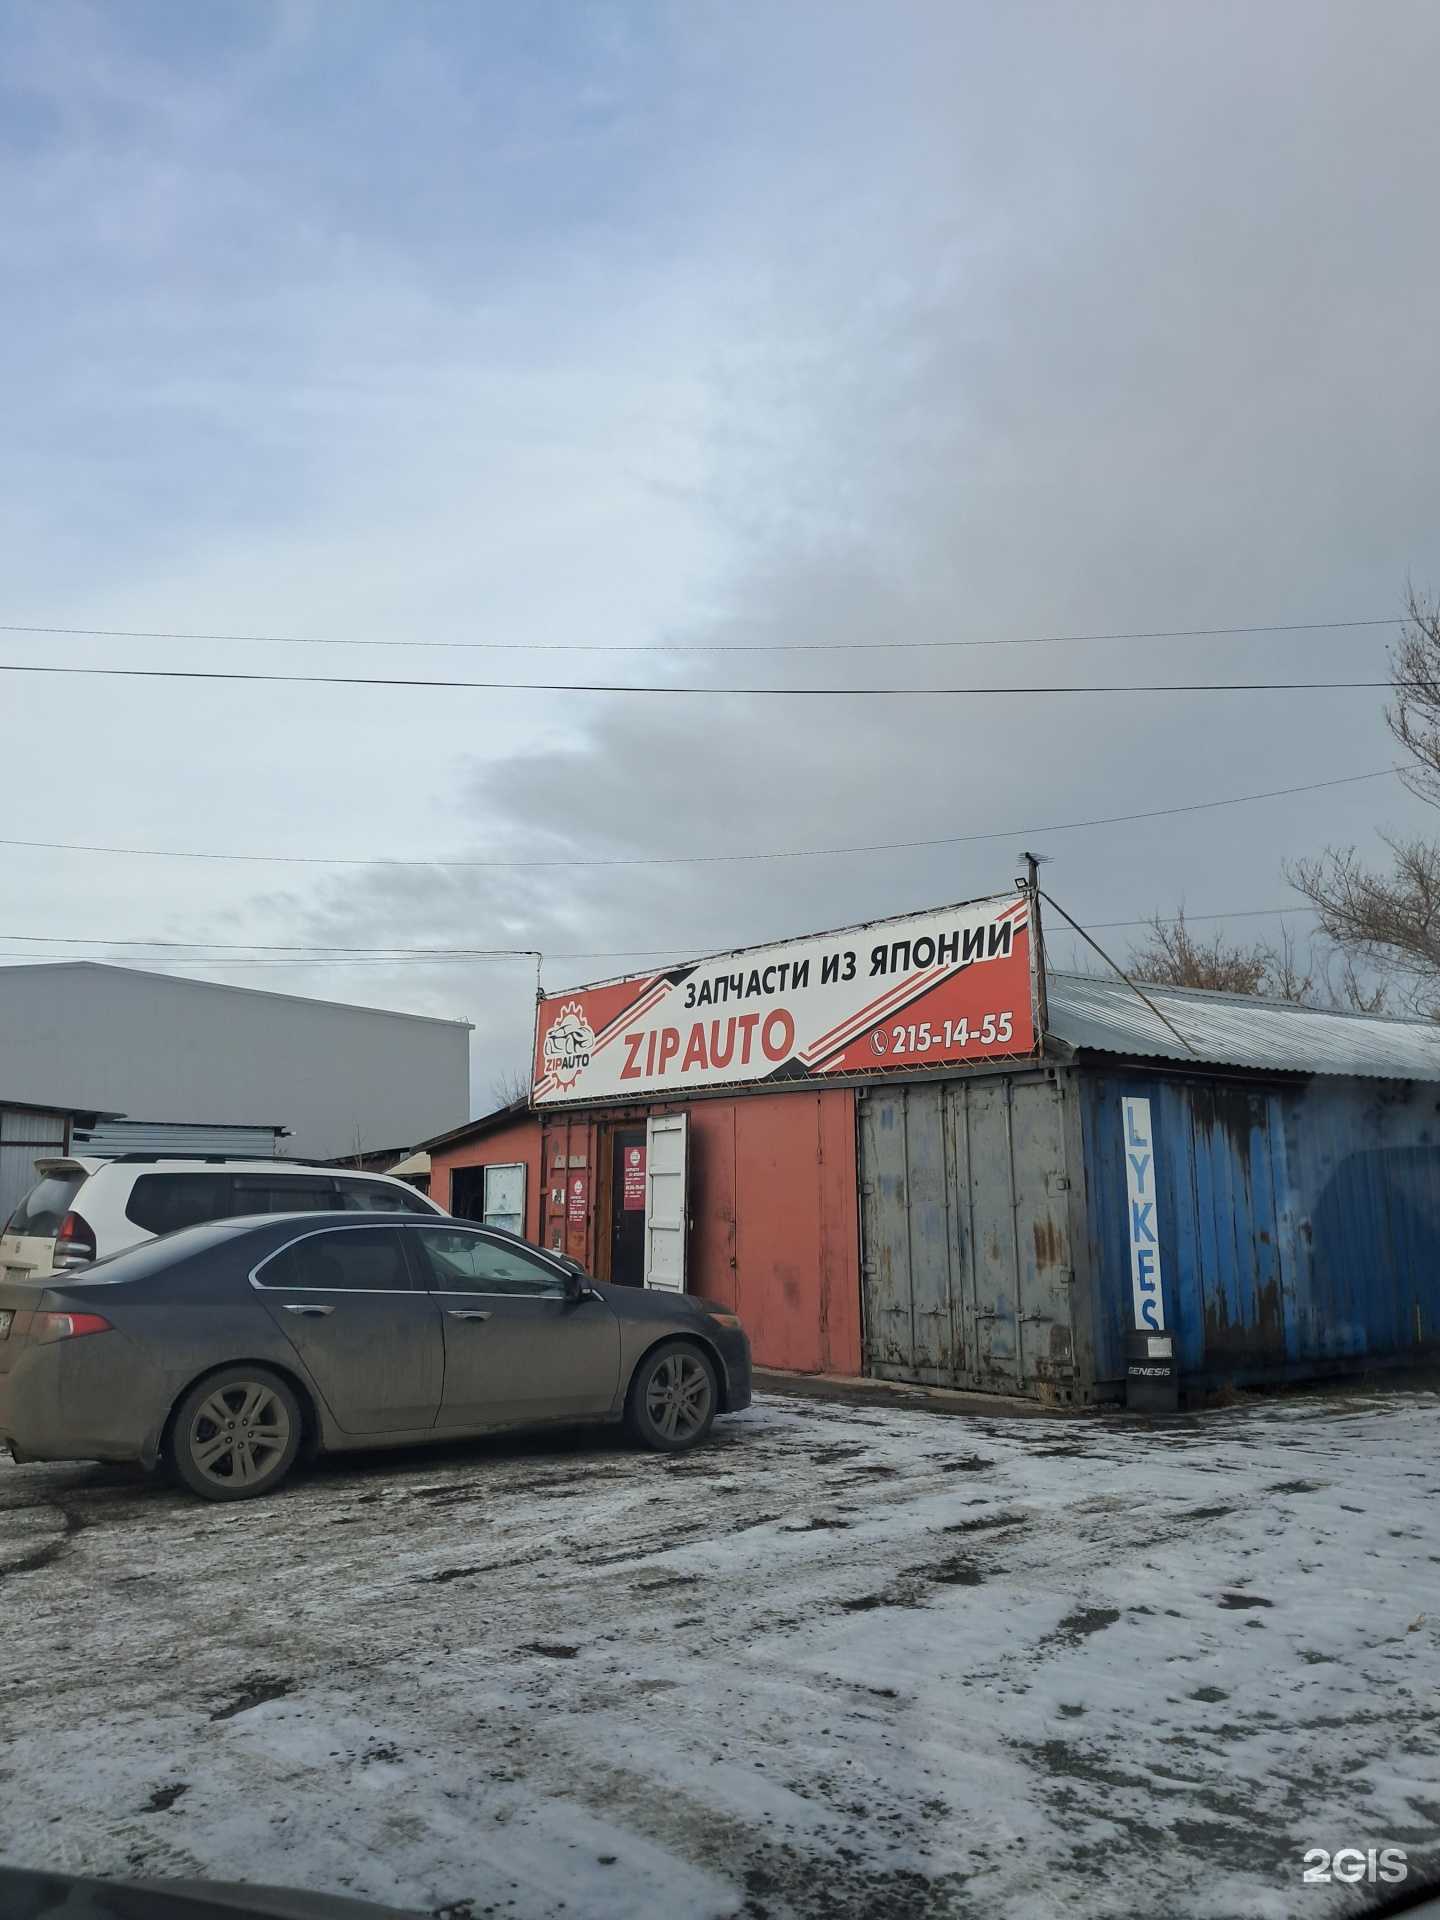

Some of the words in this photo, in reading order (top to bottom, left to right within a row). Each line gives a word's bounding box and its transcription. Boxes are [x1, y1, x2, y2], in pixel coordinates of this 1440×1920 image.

[684, 959, 810, 1009] ЗАПЧАСТИ
[821, 951, 857, 985] ИЗ
[869, 921, 1012, 977] ЯПОНИИ
[620, 1008, 795, 1080] ZIPAUTO
[892, 1011, 1013, 1053] 215-14-55
[546, 1053, 590, 1072] ZIPAUTO
[1127, 1106, 1160, 1330] LYKES
[1128, 1366, 1171, 1376] GENESIS
